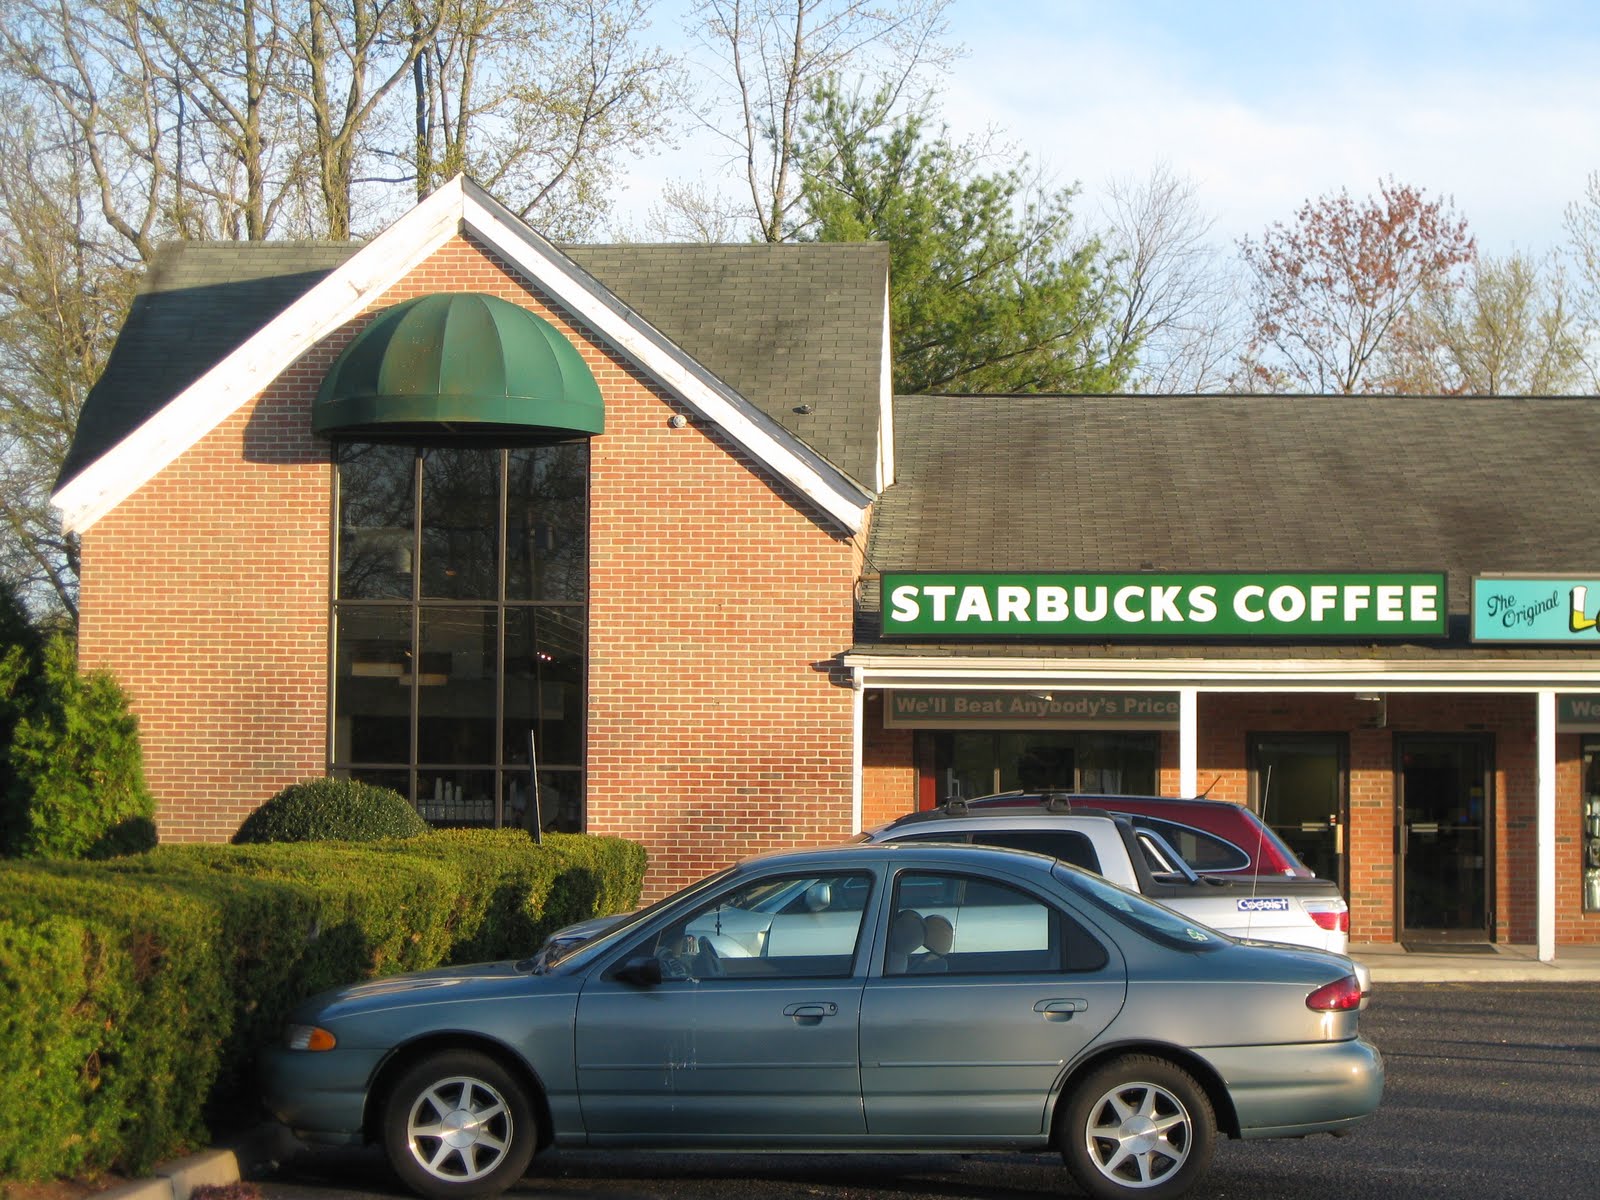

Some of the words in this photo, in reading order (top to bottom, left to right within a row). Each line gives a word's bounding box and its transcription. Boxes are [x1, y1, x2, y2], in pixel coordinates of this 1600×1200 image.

[891, 585, 1218, 622] STARBUCKS
[1233, 585, 1438, 622] COFFEE
[1487, 594, 1517, 617] The
[1502, 590, 1560, 628] Original
[1569, 585, 1600, 633] L
[896, 696, 947, 713] We'll
[954, 697, 1003, 713] Beat
[1009, 697, 1117, 717] Anybody's
